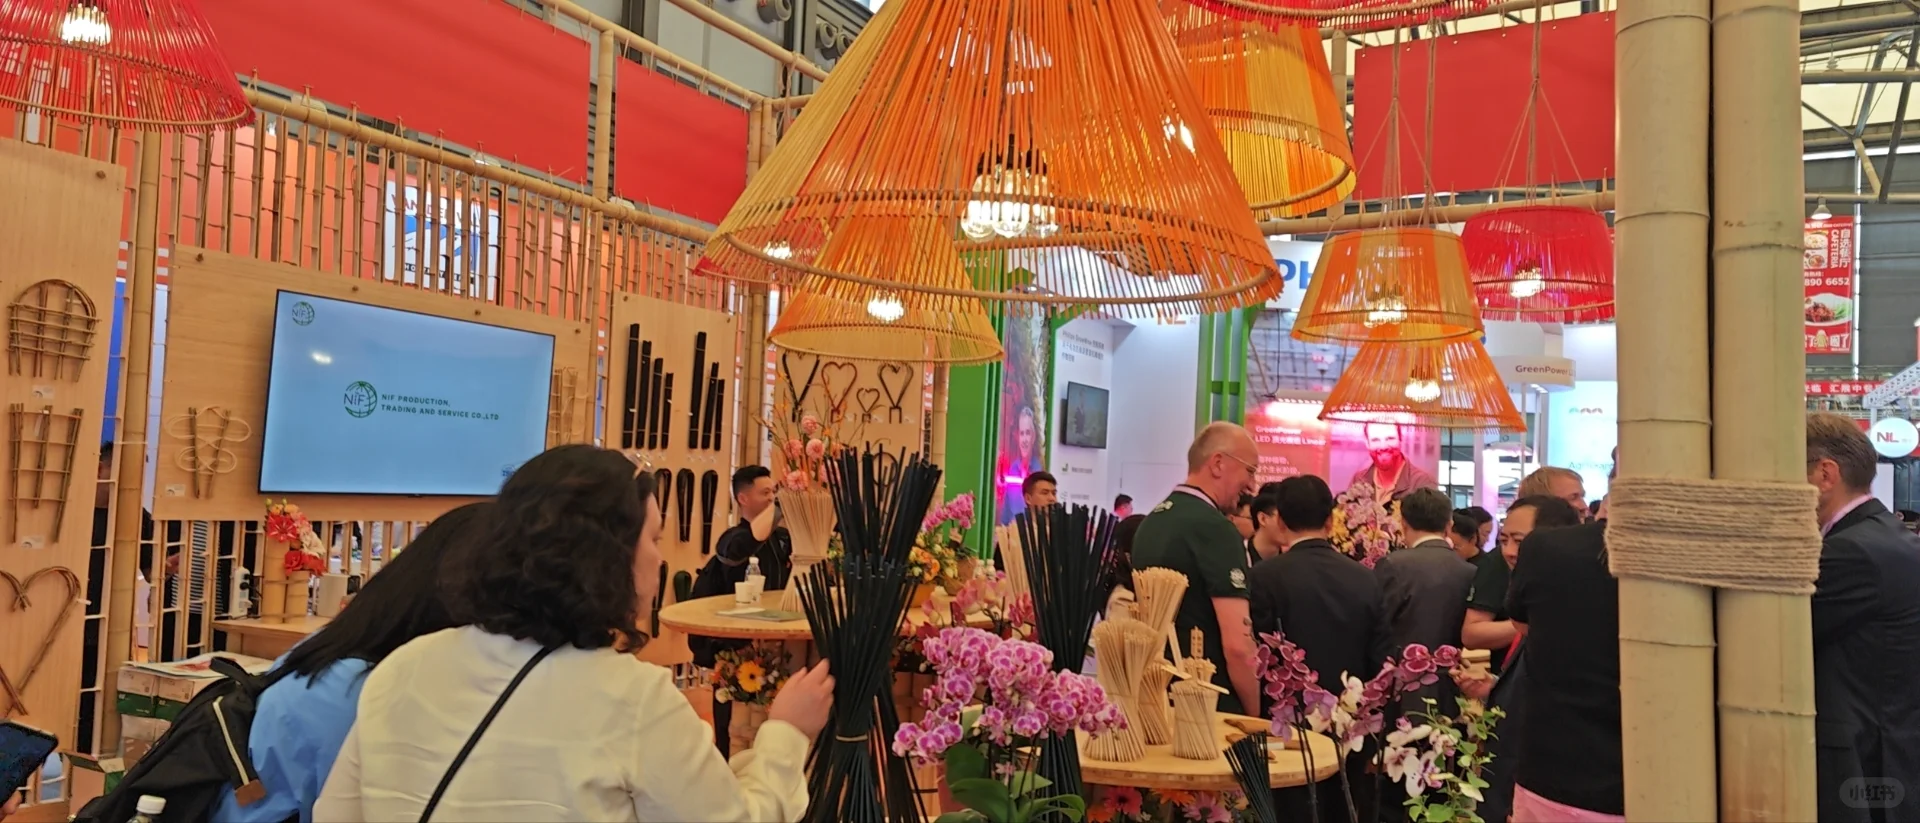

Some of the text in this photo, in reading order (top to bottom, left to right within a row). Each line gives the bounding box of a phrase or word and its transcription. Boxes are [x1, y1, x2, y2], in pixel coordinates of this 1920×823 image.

[1831, 229, 1839, 269] CAFETERIA
[1825, 277, 1850, 286] 6652
[1515, 364, 1568, 375] GreenPower
[381, 393, 450, 407] NIF PRODUCTION,
[381, 404, 417, 414] TRADING
[419, 408, 436, 416] AND
[437, 409, 469, 419] SERVICE
[1255, 434, 1271, 443] LED
